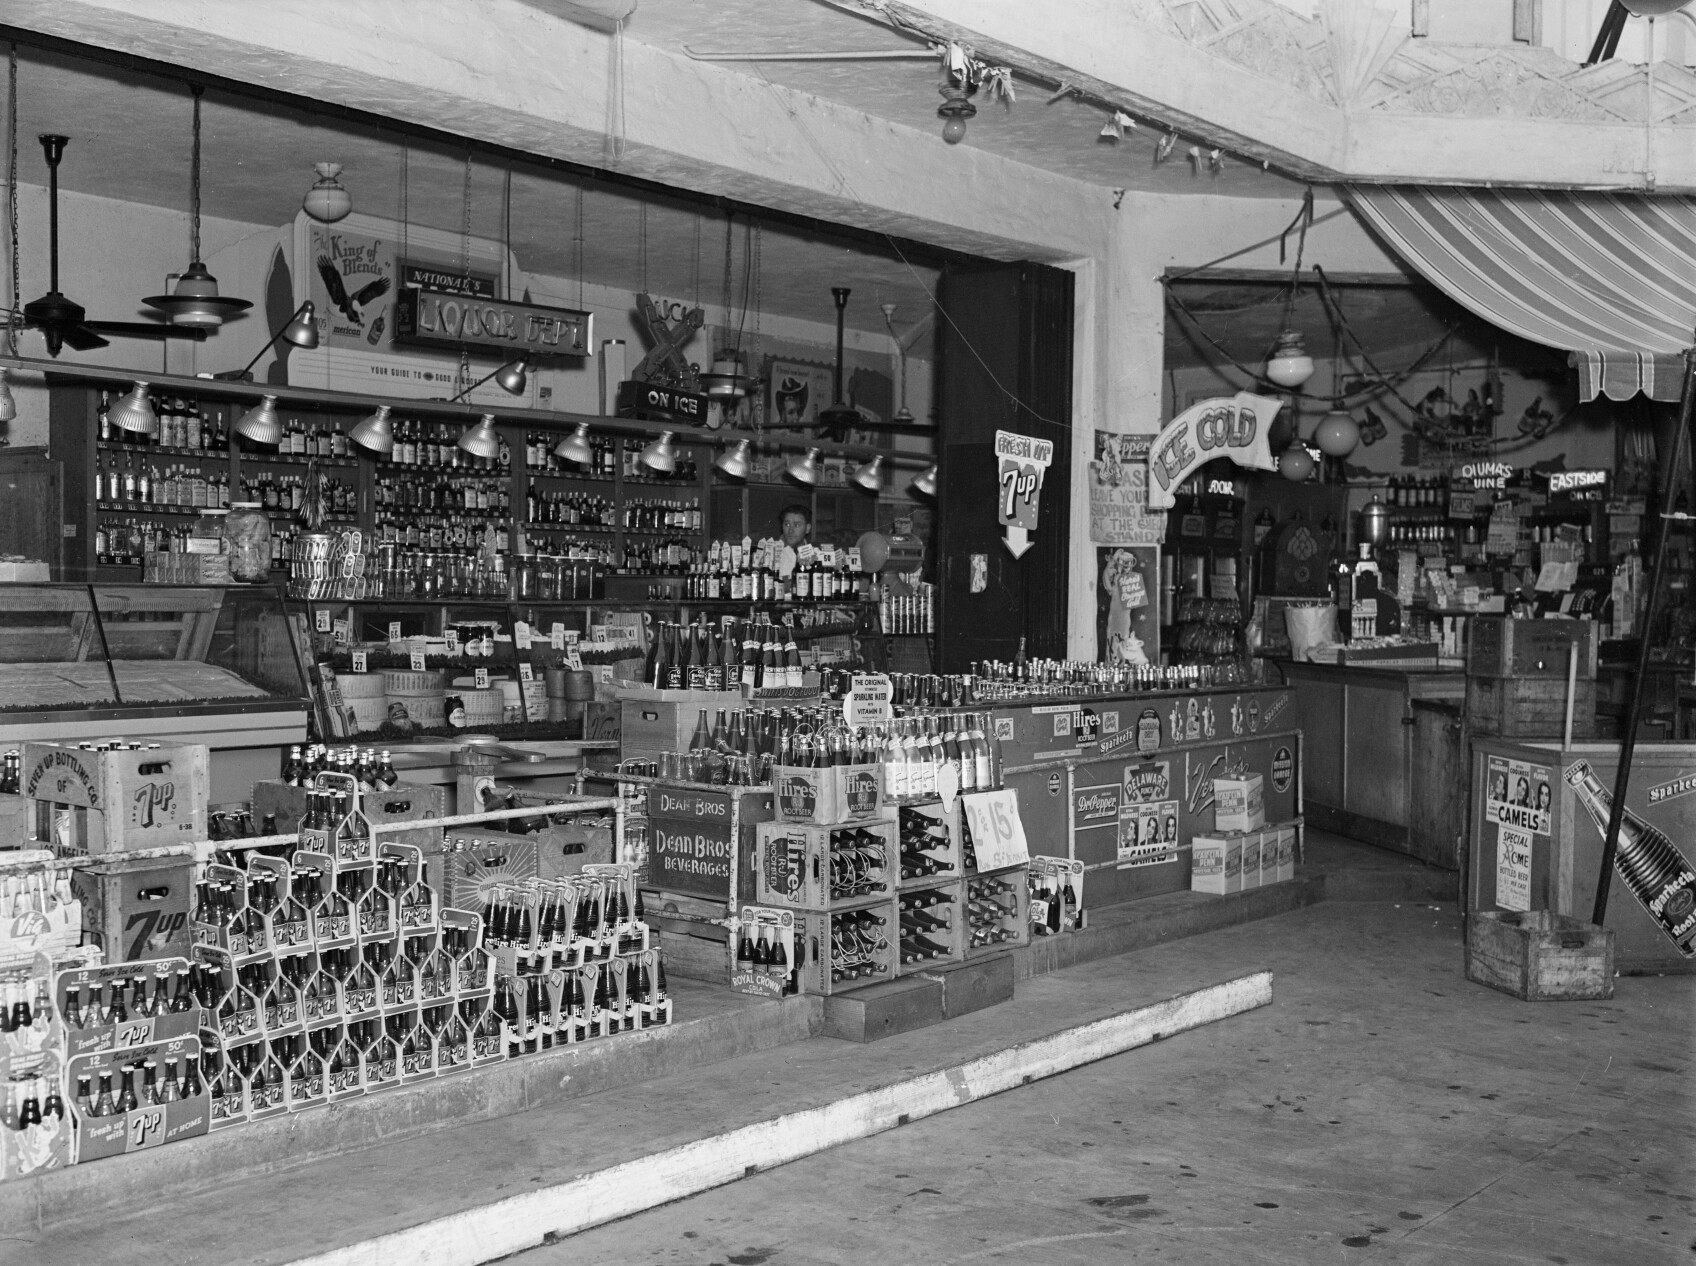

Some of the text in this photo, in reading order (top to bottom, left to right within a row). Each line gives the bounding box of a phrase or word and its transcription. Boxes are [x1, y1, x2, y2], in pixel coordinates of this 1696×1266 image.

[366, 240, 381, 263] of
[370, 366, 388, 376] YOUR
[391, 368, 410, 378] GUIDE
[413, 371, 422, 380] TO
[648, 390, 698, 415] ON ICE
[1153, 405, 1257, 491] ICE COLD
[1550, 471, 1606, 491] EASTSIDE
[1110, 518, 1134, 532] THE
[354, 662, 363, 671] 27
[1073, 711, 1101, 728] Hires
[56, 752, 90, 787] BOTTLING
[1509, 768, 1529, 777] COOLNESS
[57, 779, 67, 793] OF
[778, 778, 818, 799] Hires
[845, 775, 879, 794] Hires
[1126, 772, 1167, 796] DELAWARE
[1649, 777, 1696, 801] Sparkee
[1498, 806, 1539, 831] CAMELS
[1503, 831, 1528, 847] SPECIAL
[664, 856, 729, 878] BEVERAGES
[787, 832, 807, 903] Hires
[1517, 869, 1528, 881] BEER
[731, 974, 781, 993] ROYAL CROWN
[89, 1055, 101, 1065] 12
[105, 1130, 125, 1142] with
[166, 1116, 203, 1138] AT HOME
